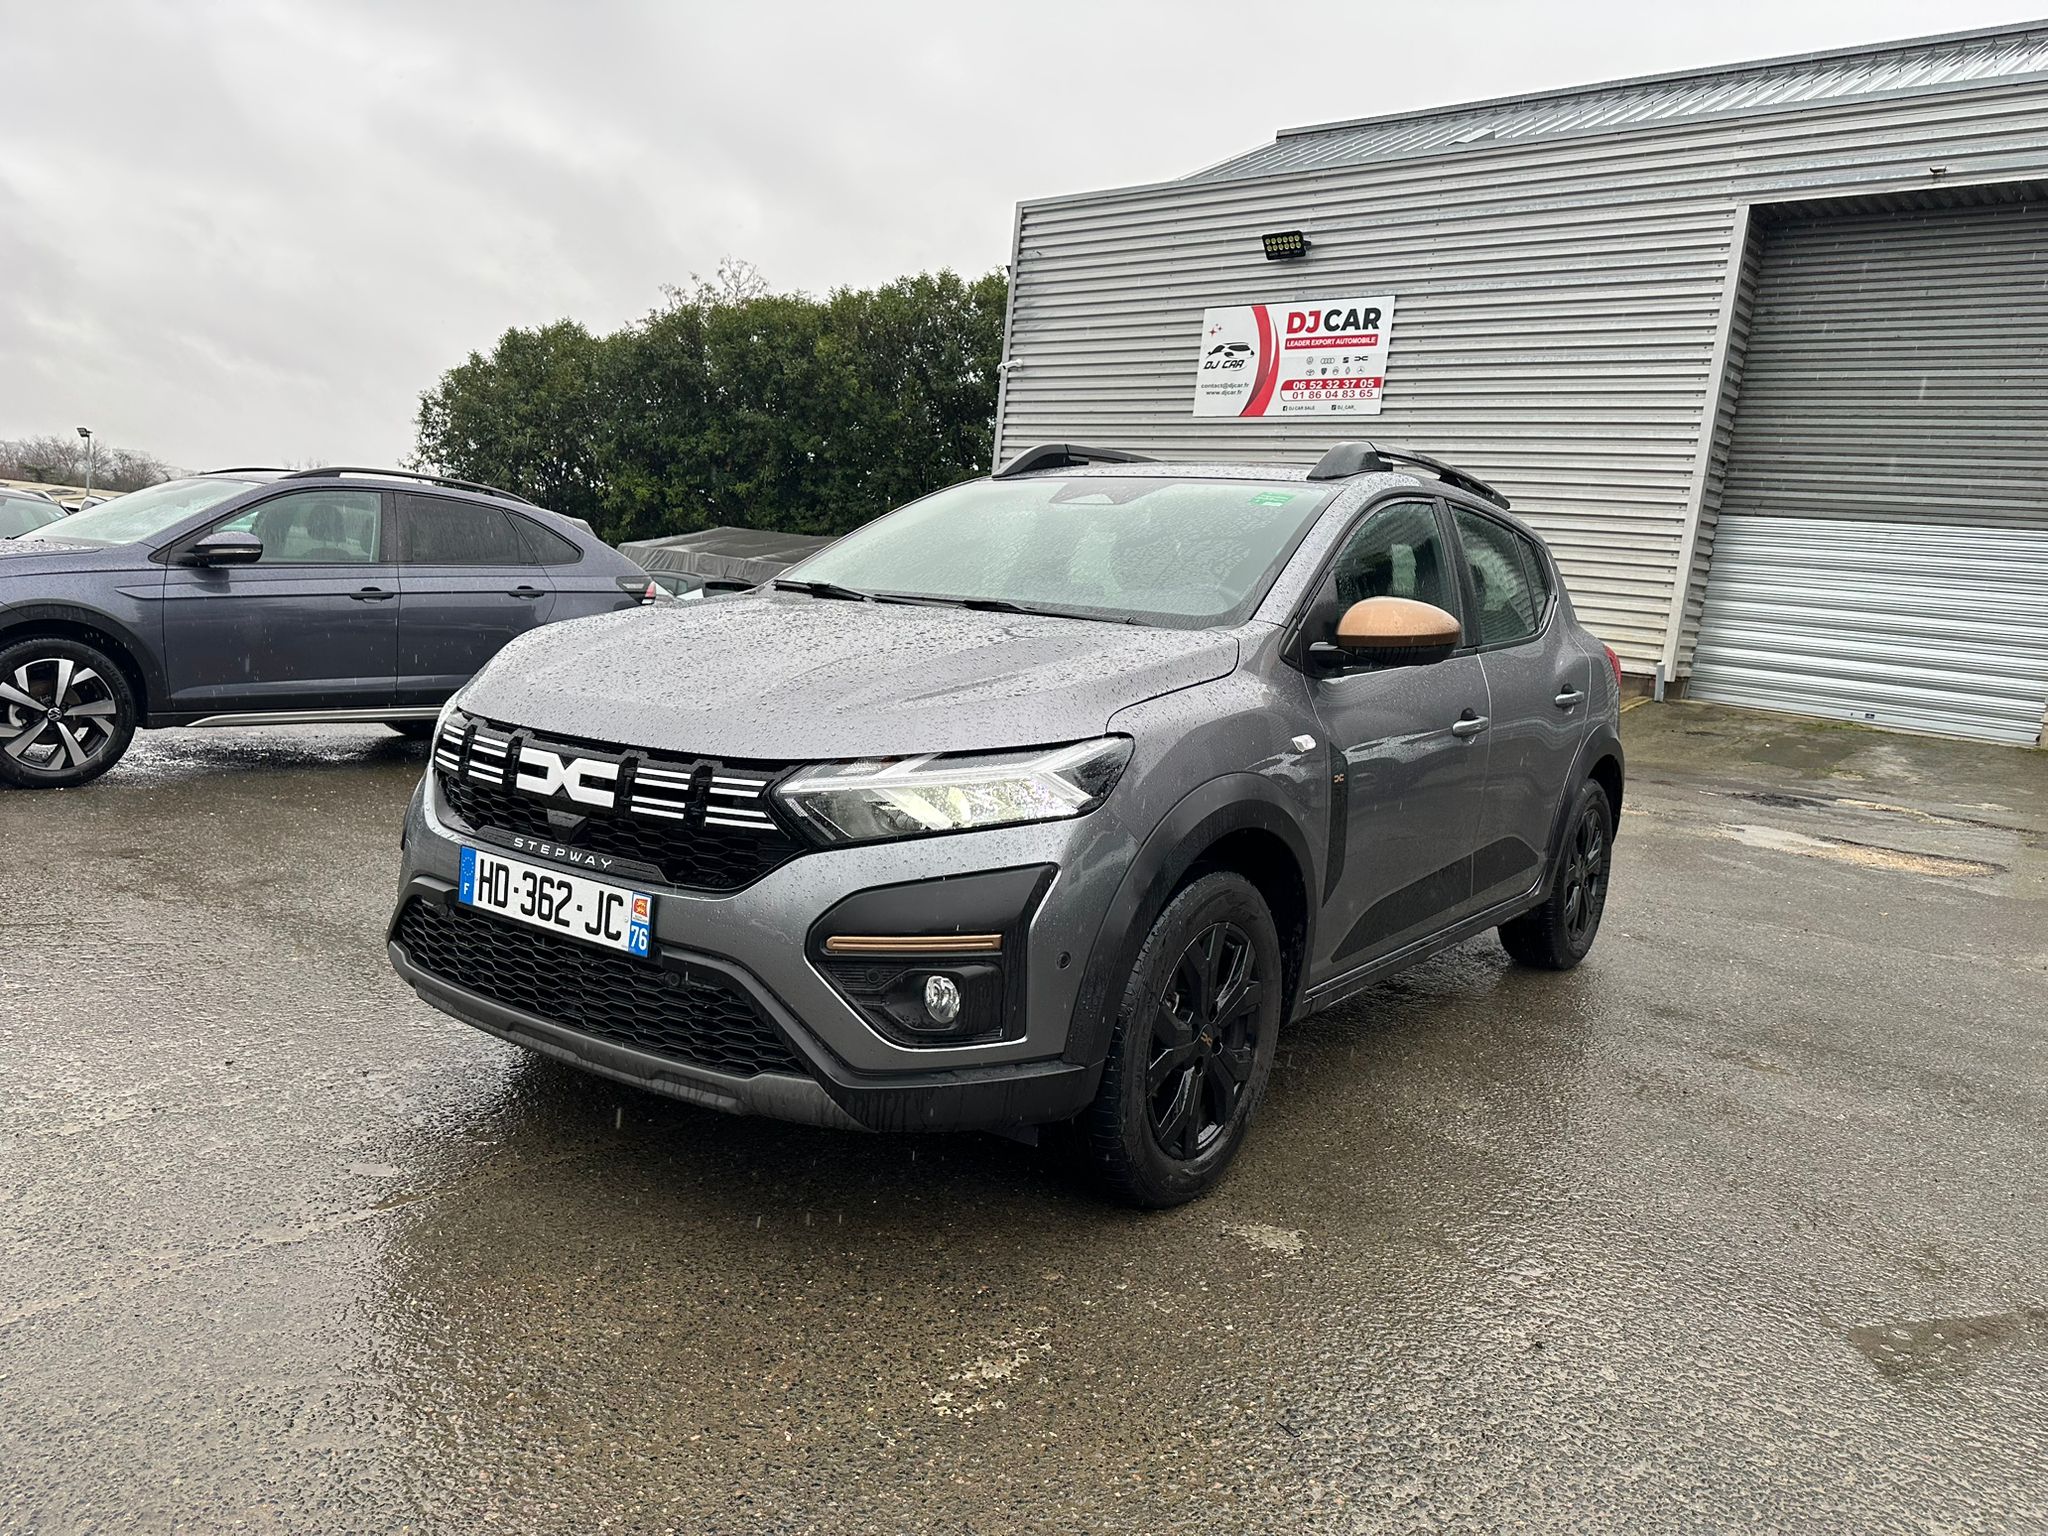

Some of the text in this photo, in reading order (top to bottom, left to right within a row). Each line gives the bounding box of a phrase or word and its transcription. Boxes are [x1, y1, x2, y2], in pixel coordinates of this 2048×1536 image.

[1286, 336, 1376, 347] LEADER EXPORT AUTOMOBILE
[1203, 359, 1245, 370] DJ CAR
[1201, 382, 1249, 390] contact@djcar.fr
[1292, 379, 1374, 390] 06 52 32 37 05
[1292, 389, 1373, 399] 01 86 04 83 65
[513, 837, 613, 869] STEPWAY
[463, 882, 470, 895] F
[630, 924, 648, 951] 76
